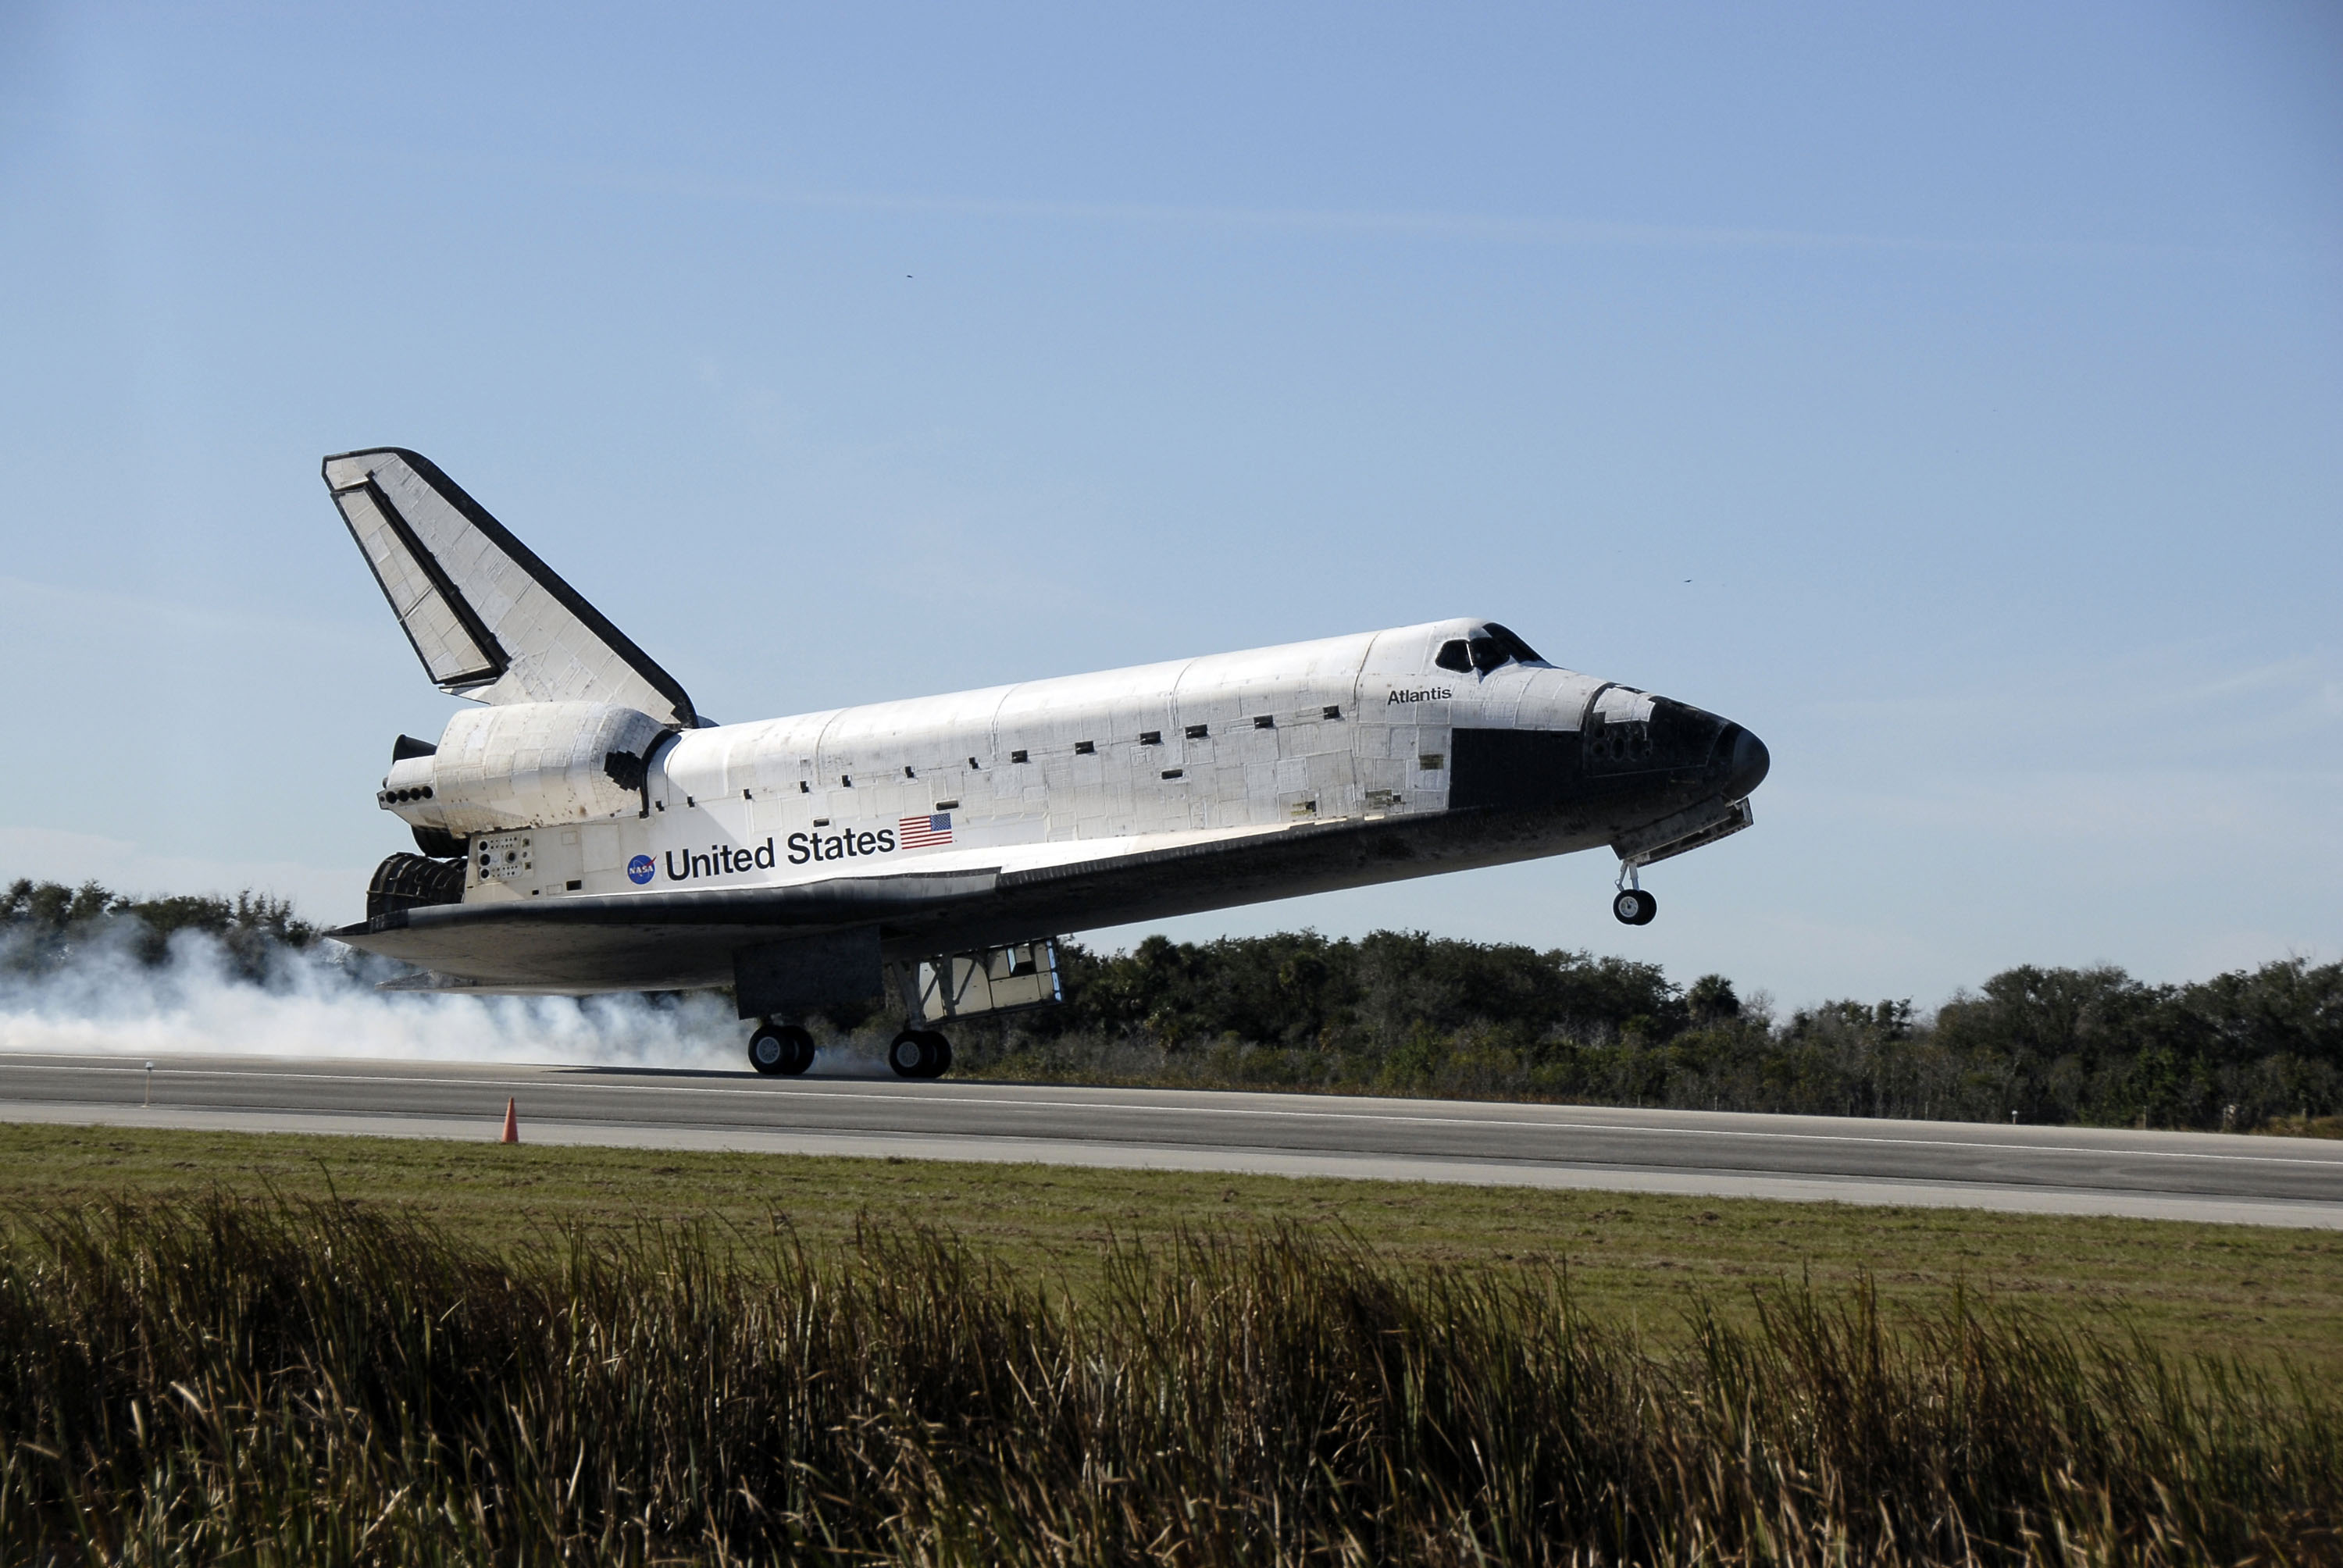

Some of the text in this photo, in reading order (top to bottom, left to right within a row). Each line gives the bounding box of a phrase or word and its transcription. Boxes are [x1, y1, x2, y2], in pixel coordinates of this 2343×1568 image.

[1387, 686, 1452, 705] Atlantis
[665, 828, 895, 881] United States
[628, 864, 654, 875] NASA
